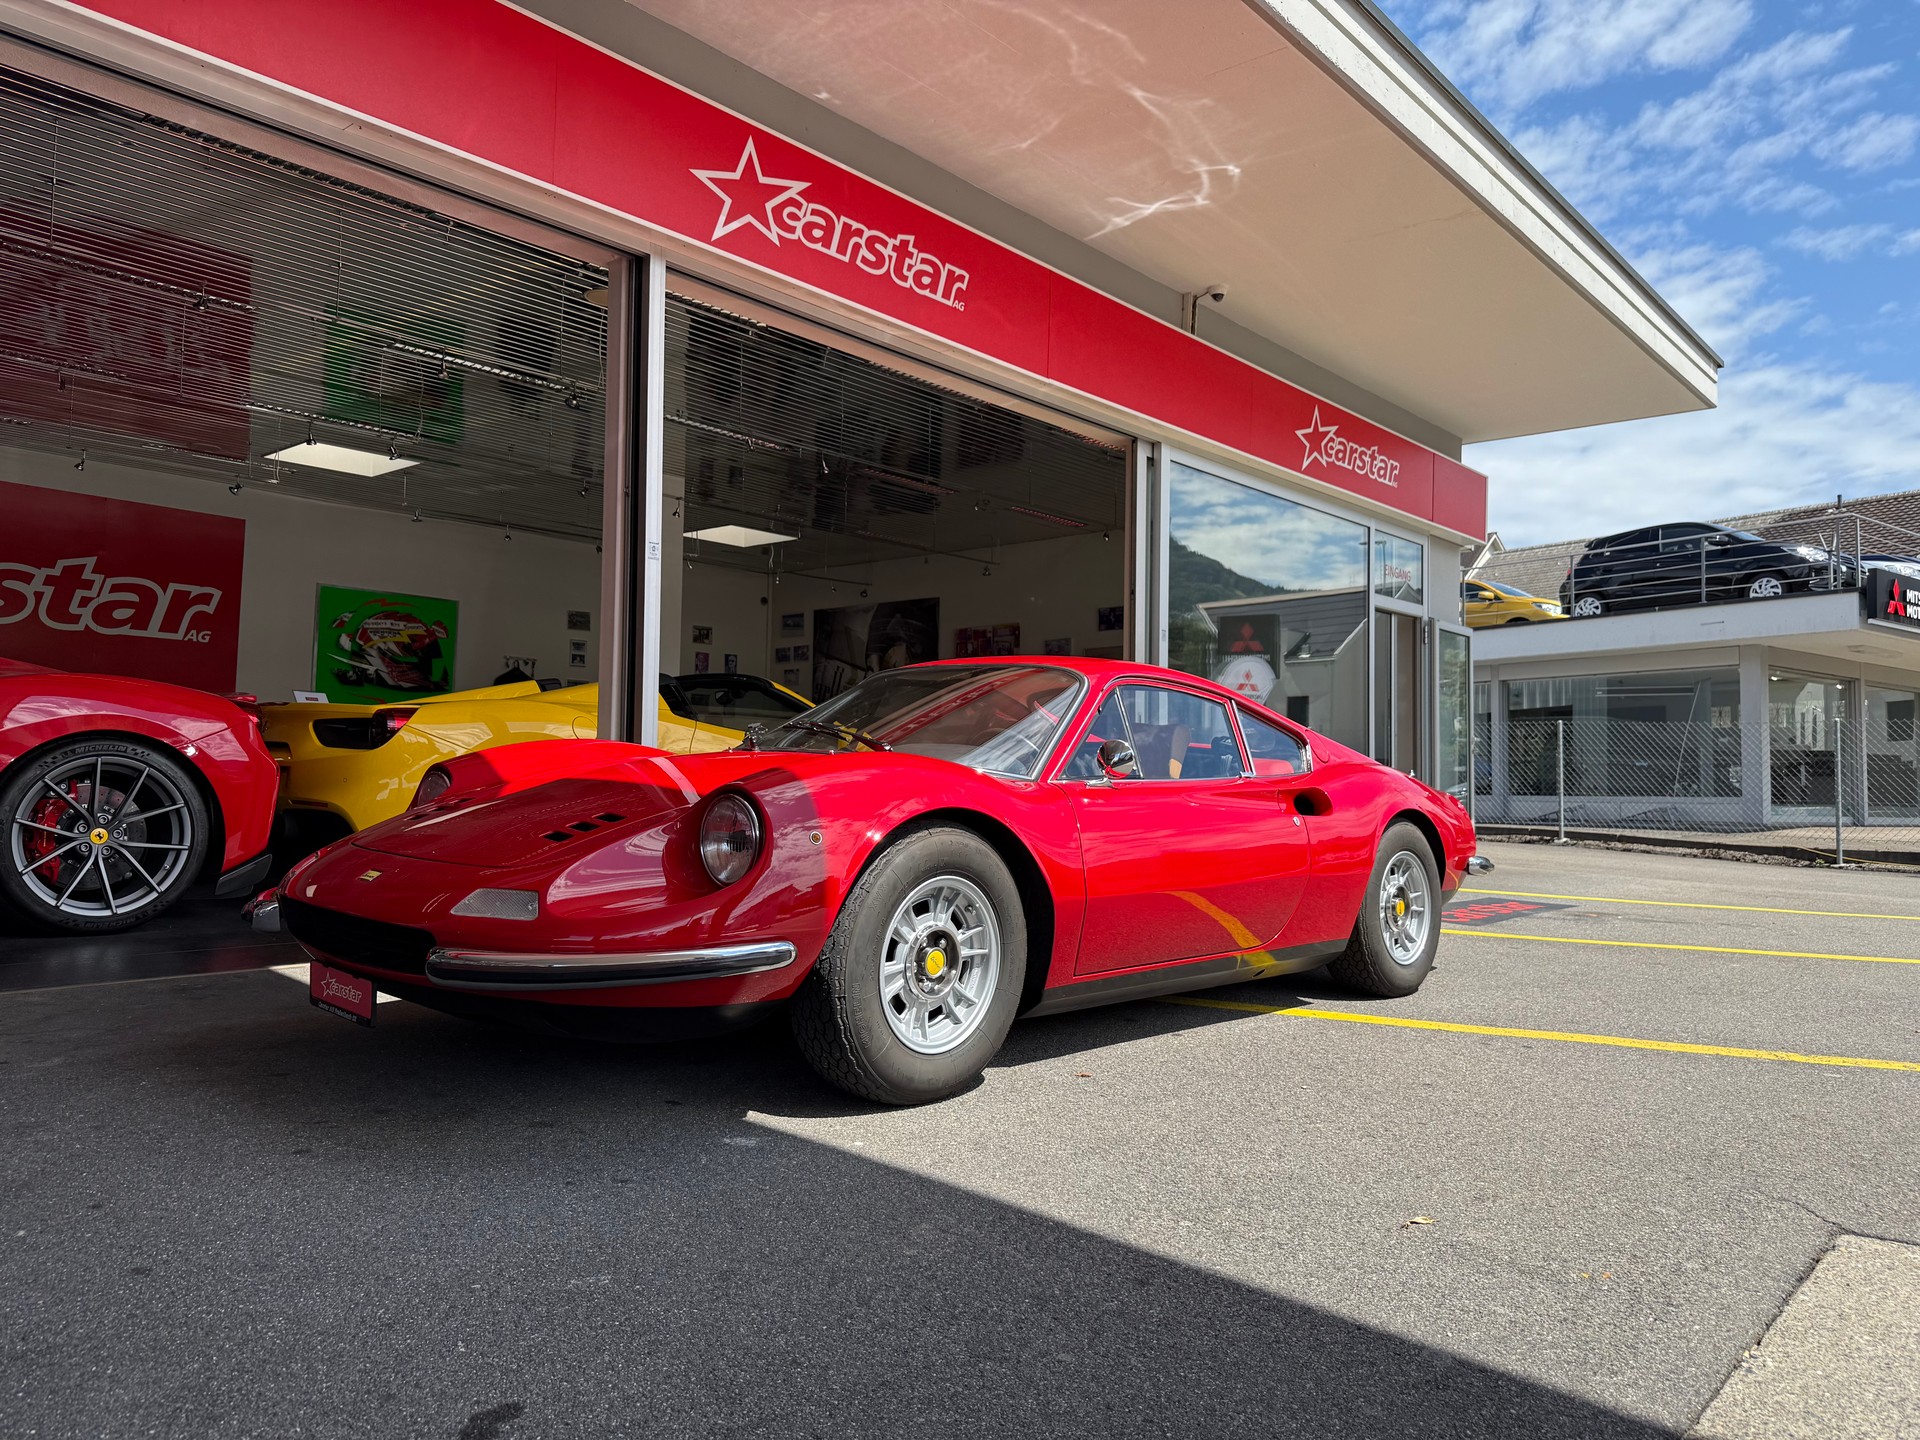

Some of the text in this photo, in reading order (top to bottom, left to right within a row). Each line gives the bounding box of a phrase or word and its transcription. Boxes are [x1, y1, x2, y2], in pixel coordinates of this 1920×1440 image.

[765, 193, 970, 312] carstar AG
[1321, 433, 1400, 487] carstar
[1385, 564, 1411, 582] EINGANG
[183, 630, 212, 643] AG
[75, 743, 128, 755] MICHELIN
[330, 981, 363, 1004] carstar
[851, 982, 873, 1049] MICHELIN
